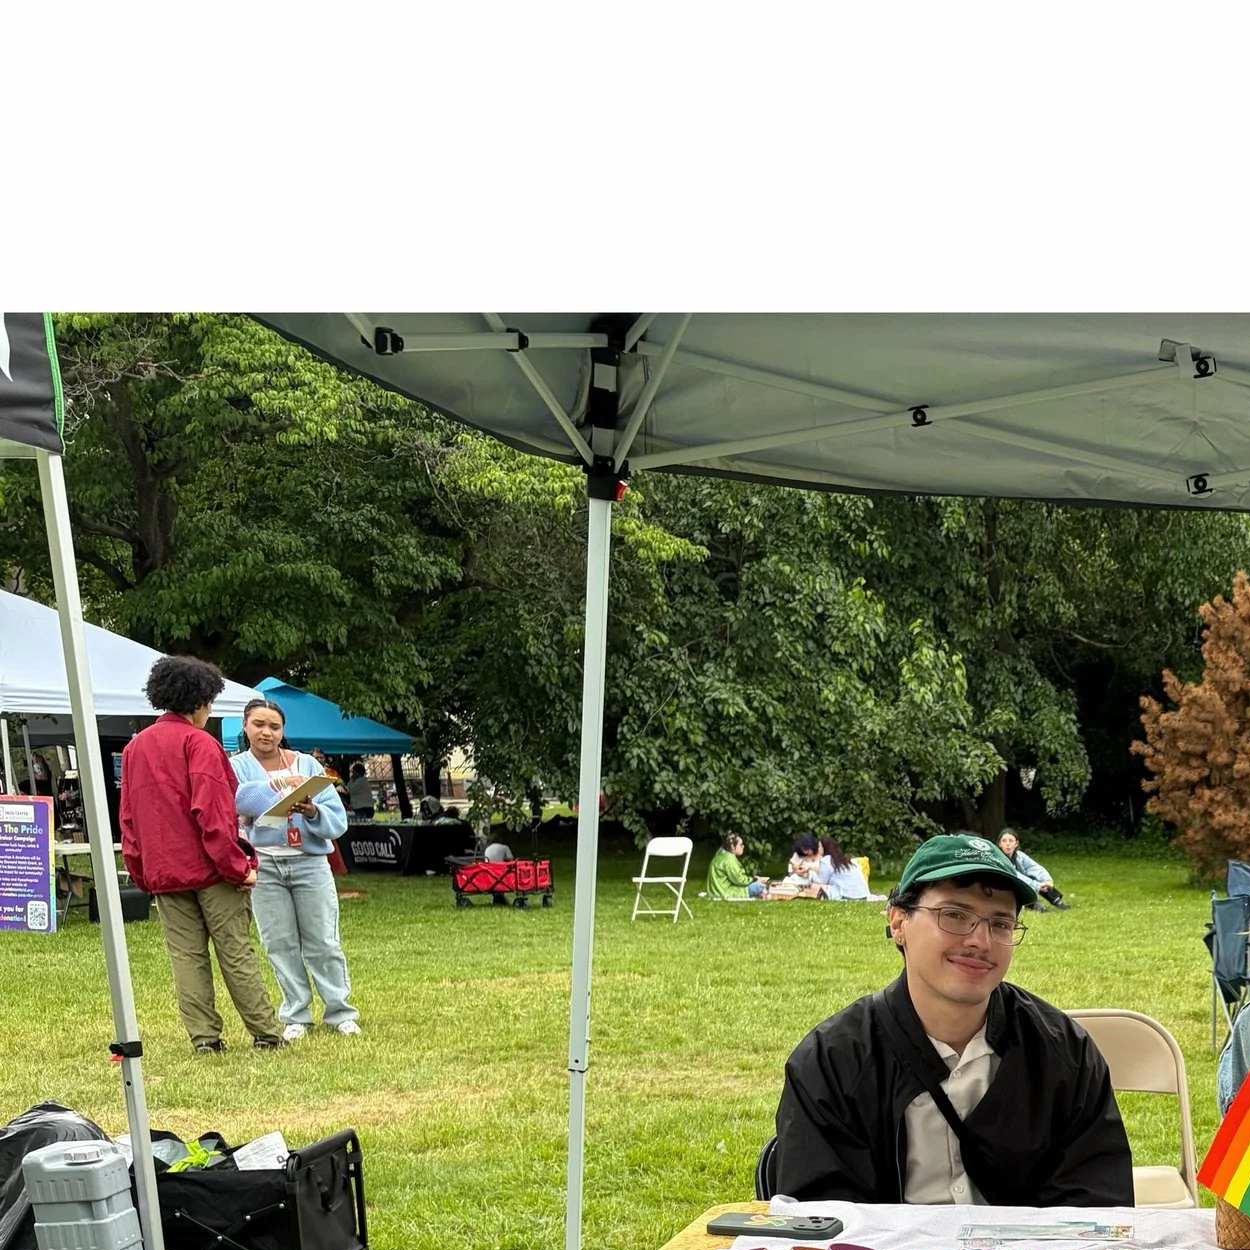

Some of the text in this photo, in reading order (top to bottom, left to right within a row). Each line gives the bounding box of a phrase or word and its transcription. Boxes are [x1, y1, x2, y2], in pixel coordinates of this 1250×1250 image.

[4, 824, 43, 835] The Pride
[351, 841, 395, 858] GOOD CALL
[4, 906, 14, 914] you
